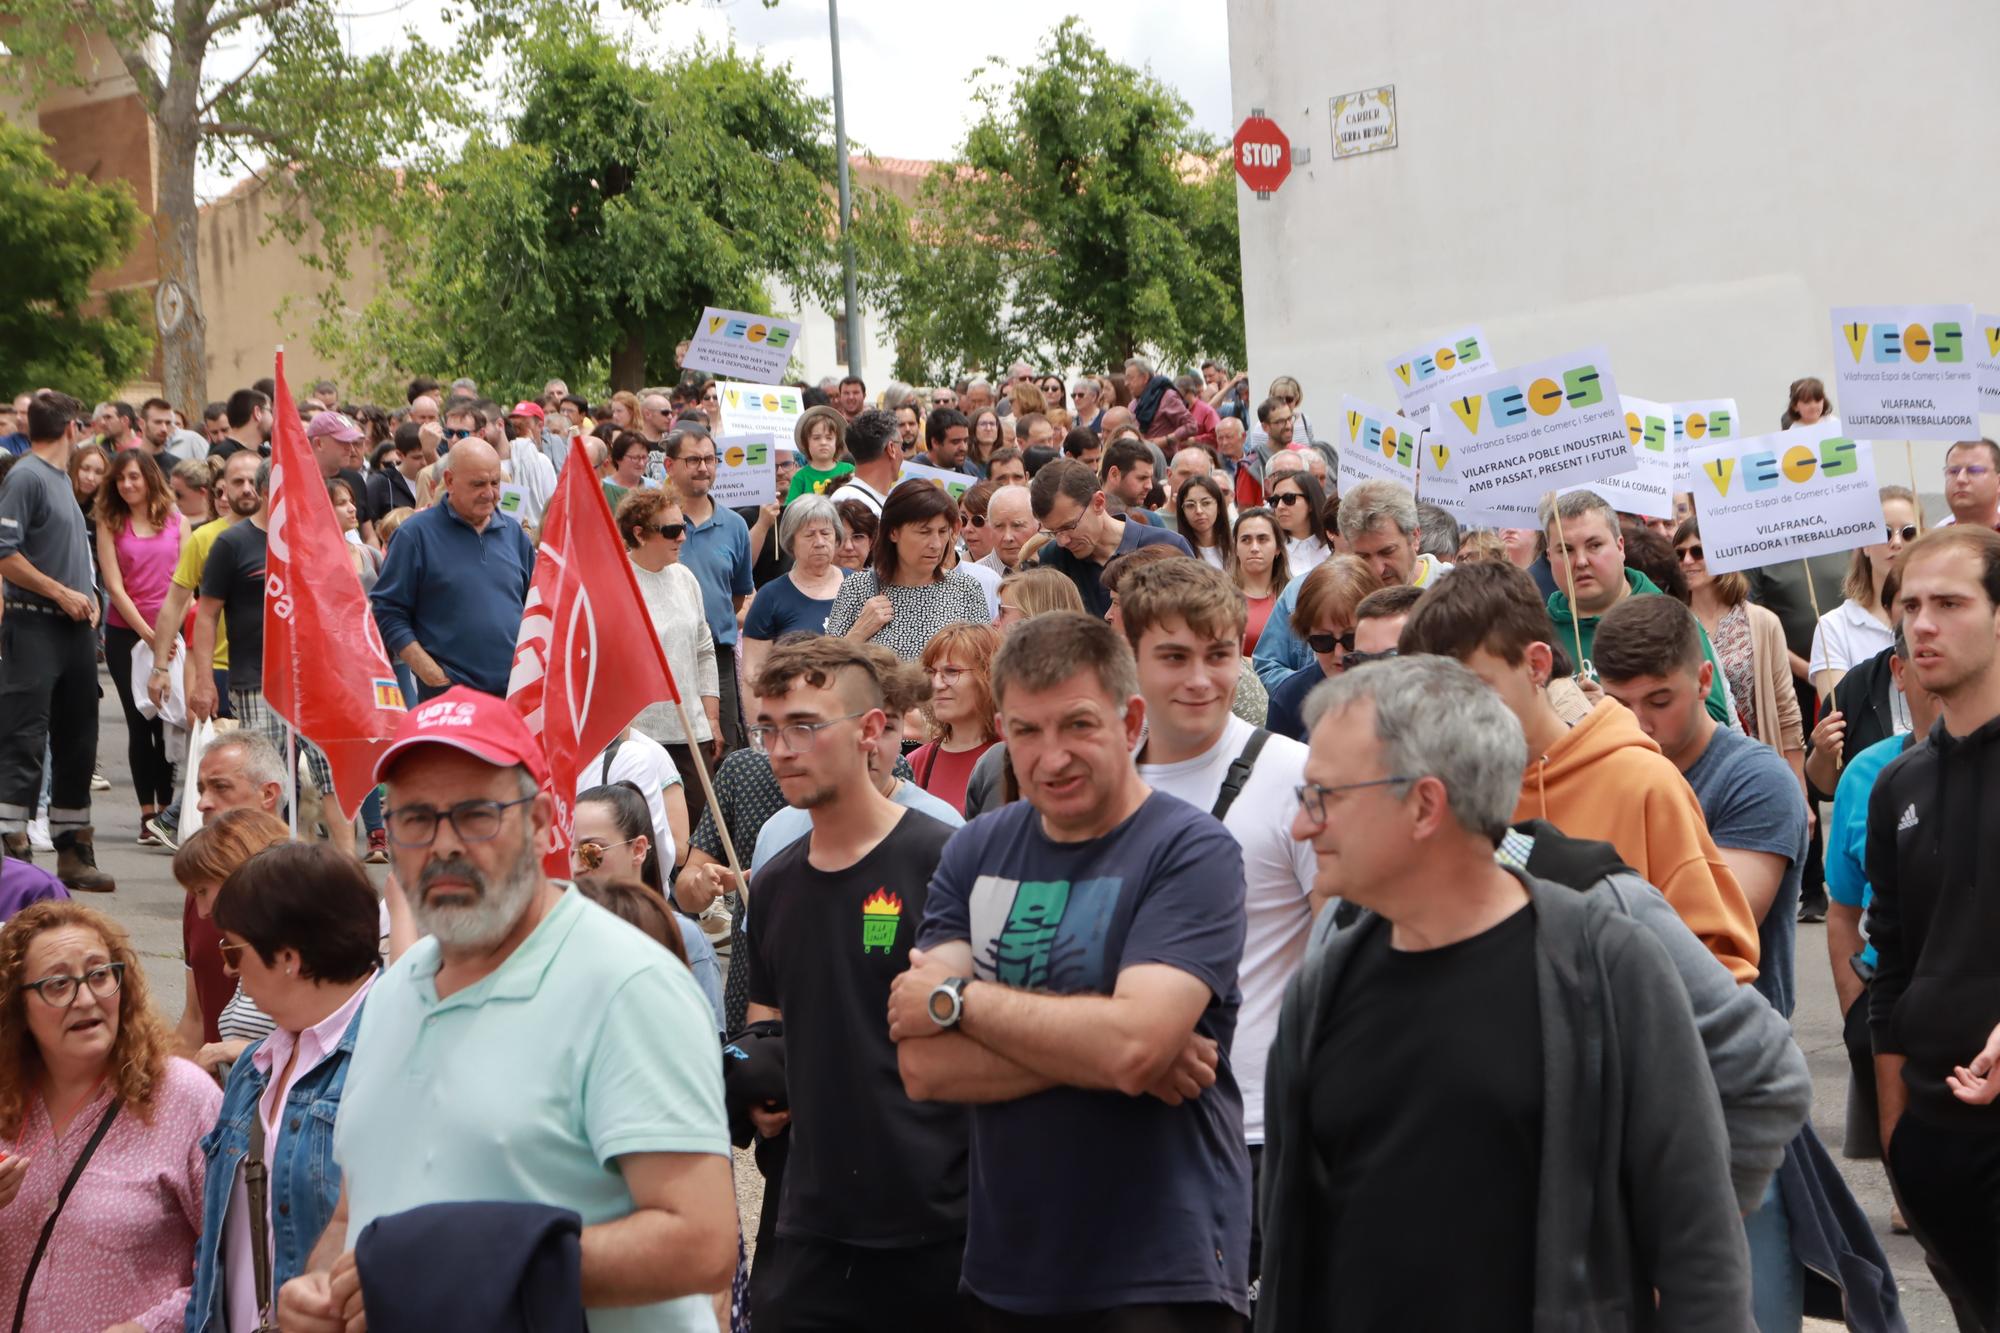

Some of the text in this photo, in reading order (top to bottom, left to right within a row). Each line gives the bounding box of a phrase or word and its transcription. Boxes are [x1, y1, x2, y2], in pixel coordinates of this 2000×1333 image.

[1346, 108, 1380, 125] CARRER
[1242, 142, 1282, 168] STOP
[708, 348, 738, 359] RECURSOS
[764, 360, 779, 368] VIDA
[1843, 371, 1880, 381] Vilafranca
[1881, 371, 1900, 382] Espai
[1902, 371, 1911, 380] de
[1912, 371, 1940, 382] Comerç
[1945, 370, 1972, 380] Serveis
[1410, 409, 1420, 417] NO
[1881, 399, 1936, 410] VILAFRANCA,
[1848, 415, 1900, 425] LLUITADORA
[1906, 415, 1973, 425] TREBALLADORA
[1460, 438, 1505, 455] Vilafranca
[1506, 431, 1530, 444] Espai
[1531, 426, 1542, 436] de
[1543, 419, 1578, 433] Comerç
[1583, 409, 1616, 424] Serveis
[1462, 455, 1527, 479] VILAFRANCA
[1528, 445, 1561, 462] POBLE
[1562, 429, 1626, 454] INDUSTRIAL
[1340, 464, 1357, 478] JUNTS,
[1468, 445, 1628, 494] AMB PASSAT, PRESENT I FUTUR
[739, 489, 760, 497] FUTUR
[1621, 480, 1630, 489] LA
[1632, 482, 1667, 496] COMARCA
[1422, 496, 1436, 504] PER
[1437, 497, 1454, 507] UNA
[1707, 502, 1753, 517] Vilafranca
[1755, 496, 1779, 509] Espai
[1781, 494, 1792, 503] de
[1794, 487, 1831, 501] Comerç
[1835, 479, 1869, 494] Serveis
[1496, 504, 1515, 512] AMB
[1756, 514, 1828, 536] VILAFRANCA,
[1715, 539, 1783, 559] LLUITADORA
[1790, 521, 1877, 545] TREBALLADORA
[417, 702, 457, 723] UGT
